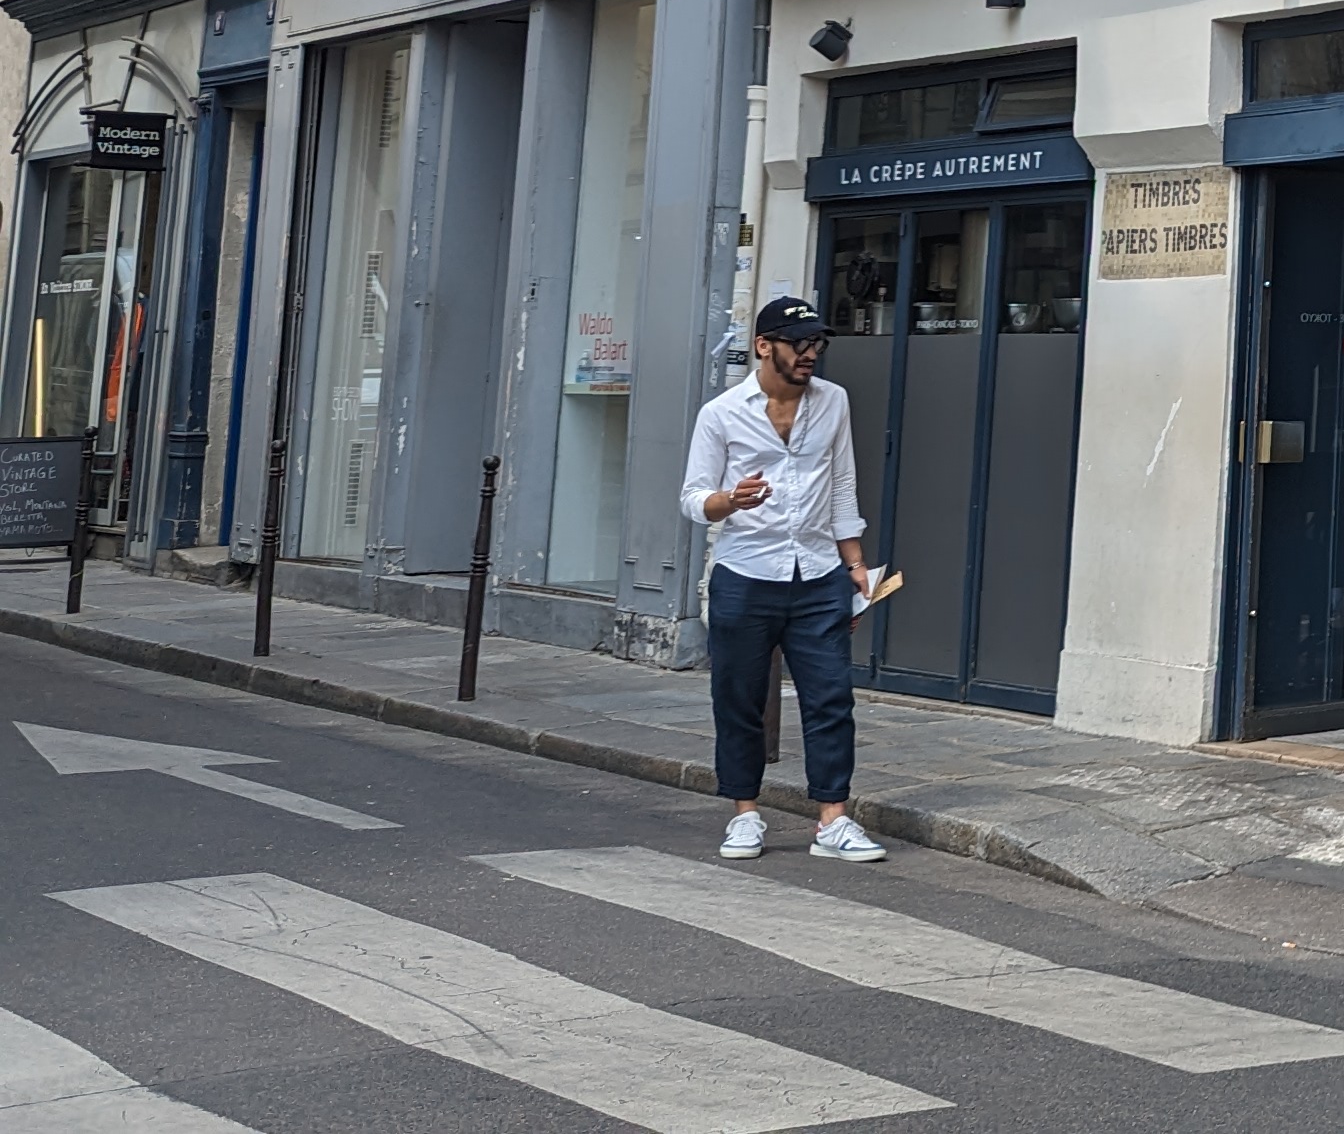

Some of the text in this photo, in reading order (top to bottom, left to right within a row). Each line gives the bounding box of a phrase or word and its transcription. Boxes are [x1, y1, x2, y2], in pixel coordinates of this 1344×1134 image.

[98, 127, 160, 140] Modern
[96, 141, 160, 158] Vintage
[840, 151, 1043, 185] LA CRÊPE AUTREMENT
[1130, 178, 1201, 209] TIMBRES
[1163, 222, 1228, 253] TIMBRES
[579, 312, 613, 335] Waldo
[594, 338, 628, 360] Balart
